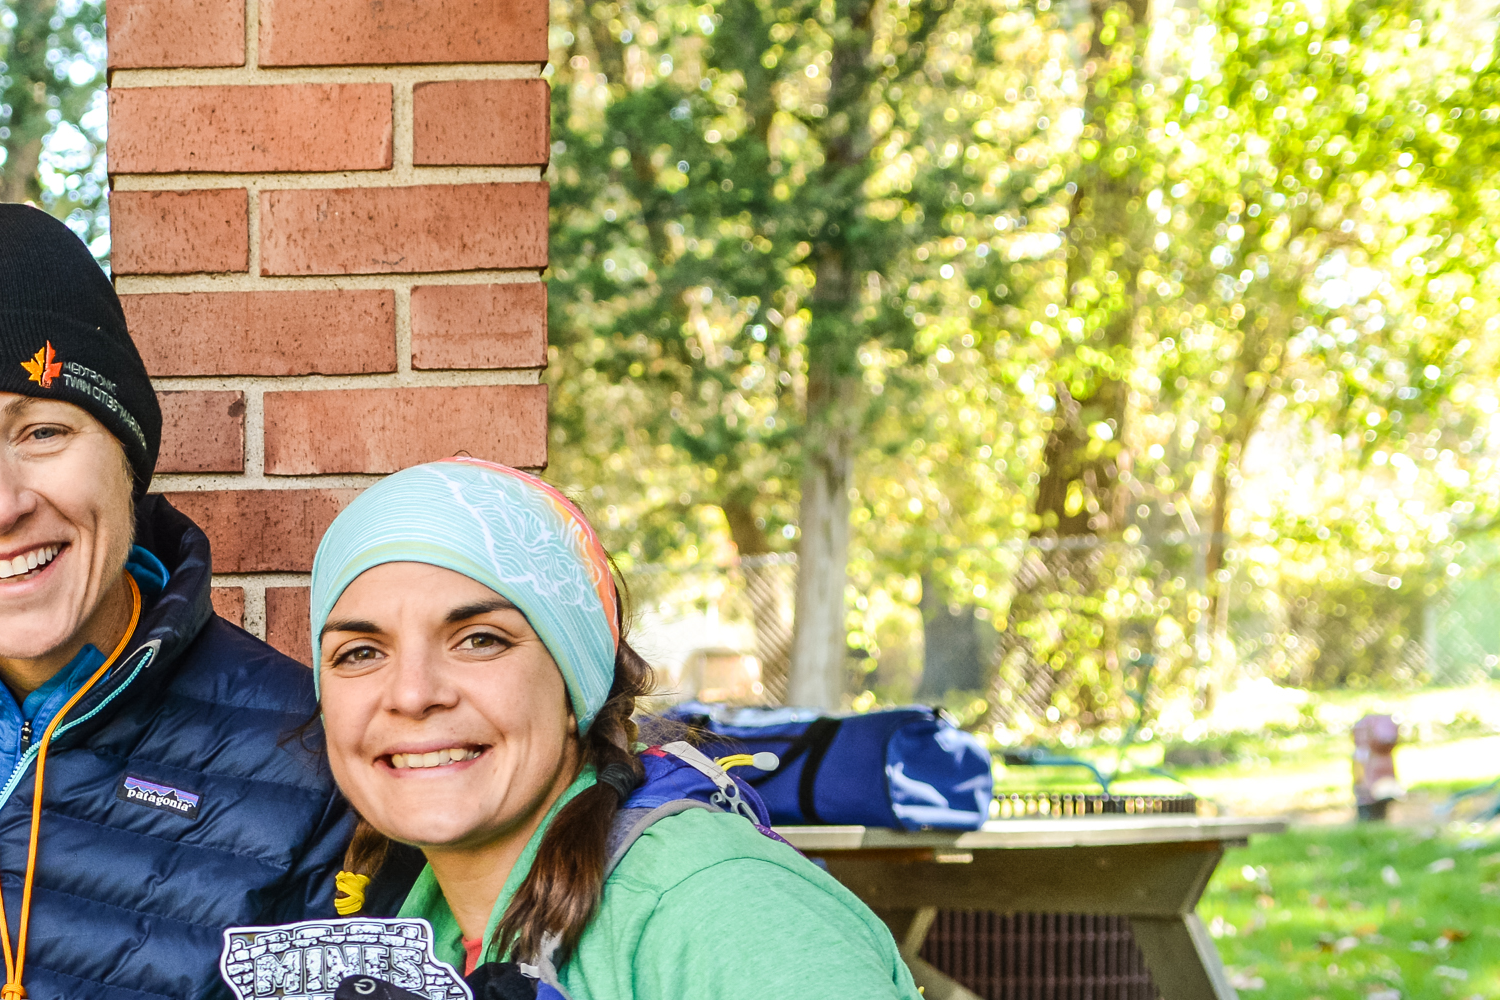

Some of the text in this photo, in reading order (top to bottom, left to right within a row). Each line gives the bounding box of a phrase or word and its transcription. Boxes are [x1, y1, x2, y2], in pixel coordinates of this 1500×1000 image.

[63, 374, 91, 395] TWIN
[92, 386, 118, 412] CITIES
[126, 789, 189, 811] patagonia
[254, 944, 425, 996] MINES
